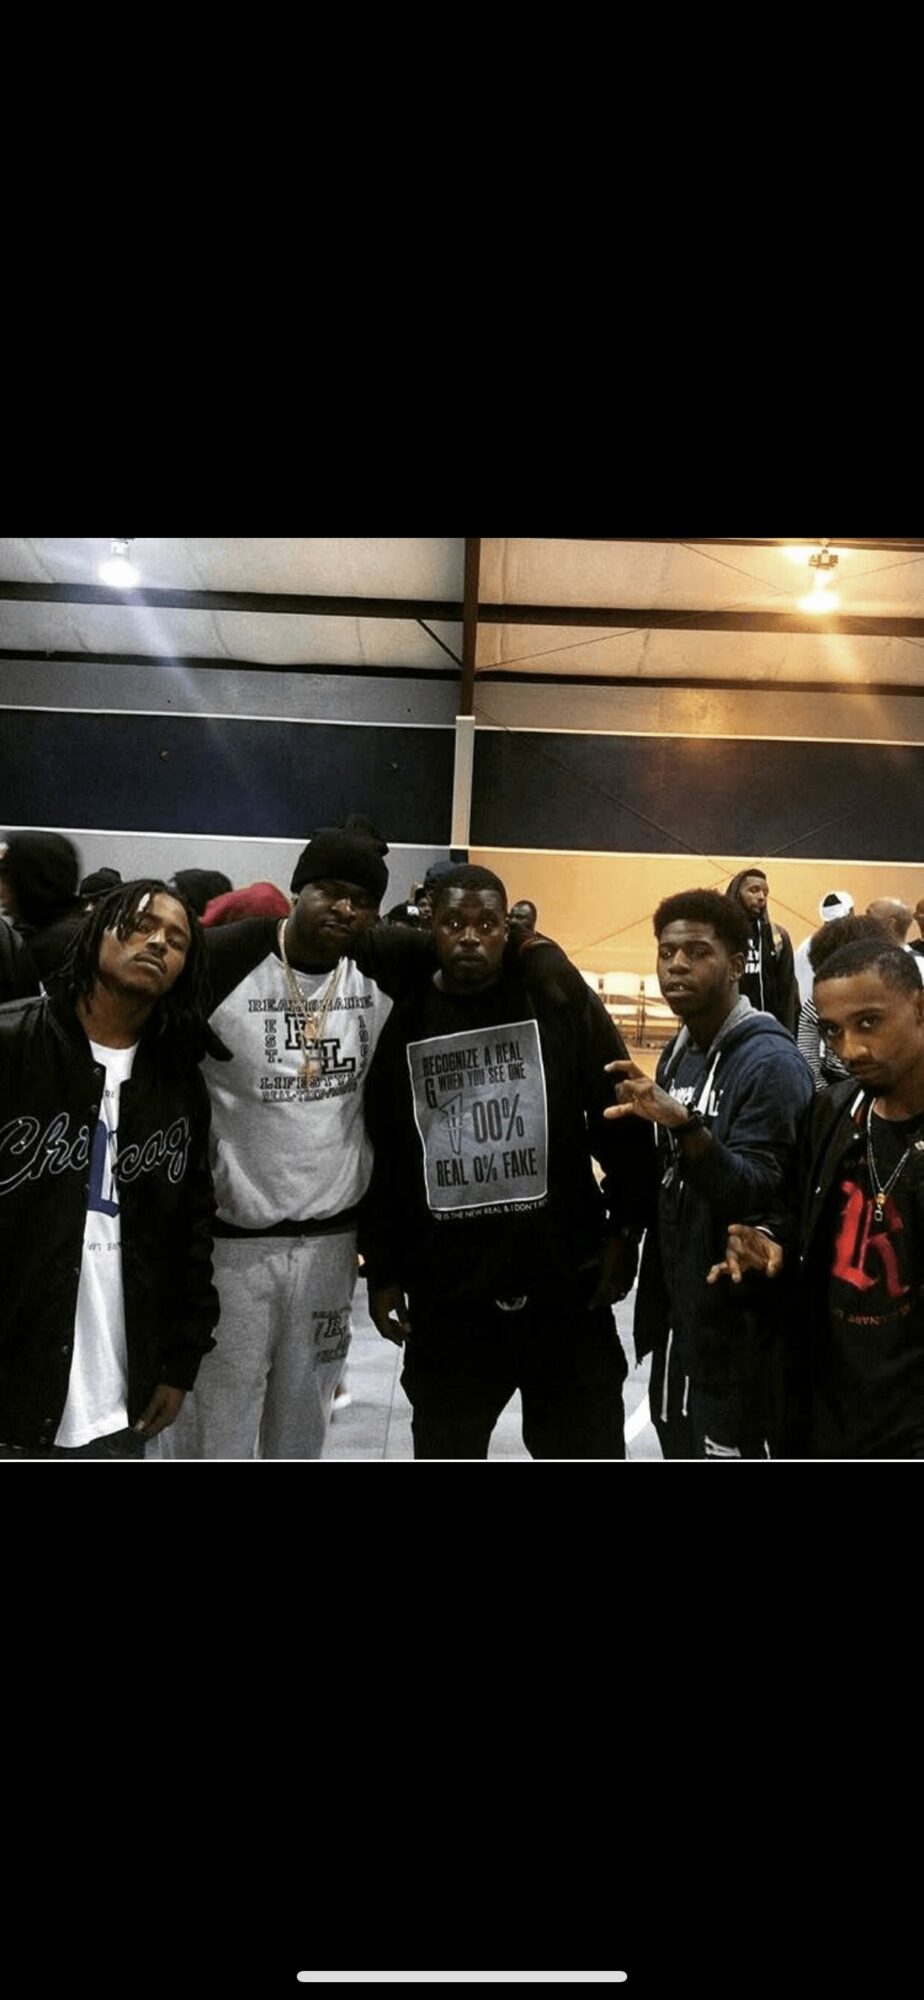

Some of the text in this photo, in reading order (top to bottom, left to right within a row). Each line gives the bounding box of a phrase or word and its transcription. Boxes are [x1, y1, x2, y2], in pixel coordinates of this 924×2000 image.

[422, 1041, 524, 1077] RECOGNIZE A REAL
[425, 1062, 527, 1109] G WHEN YOU SEE ONE
[436, 1148, 538, 1187] REAL 0% FAKE
[465, 1208, 482, 1218] NEW
[484, 1206, 502, 1216] REAL
